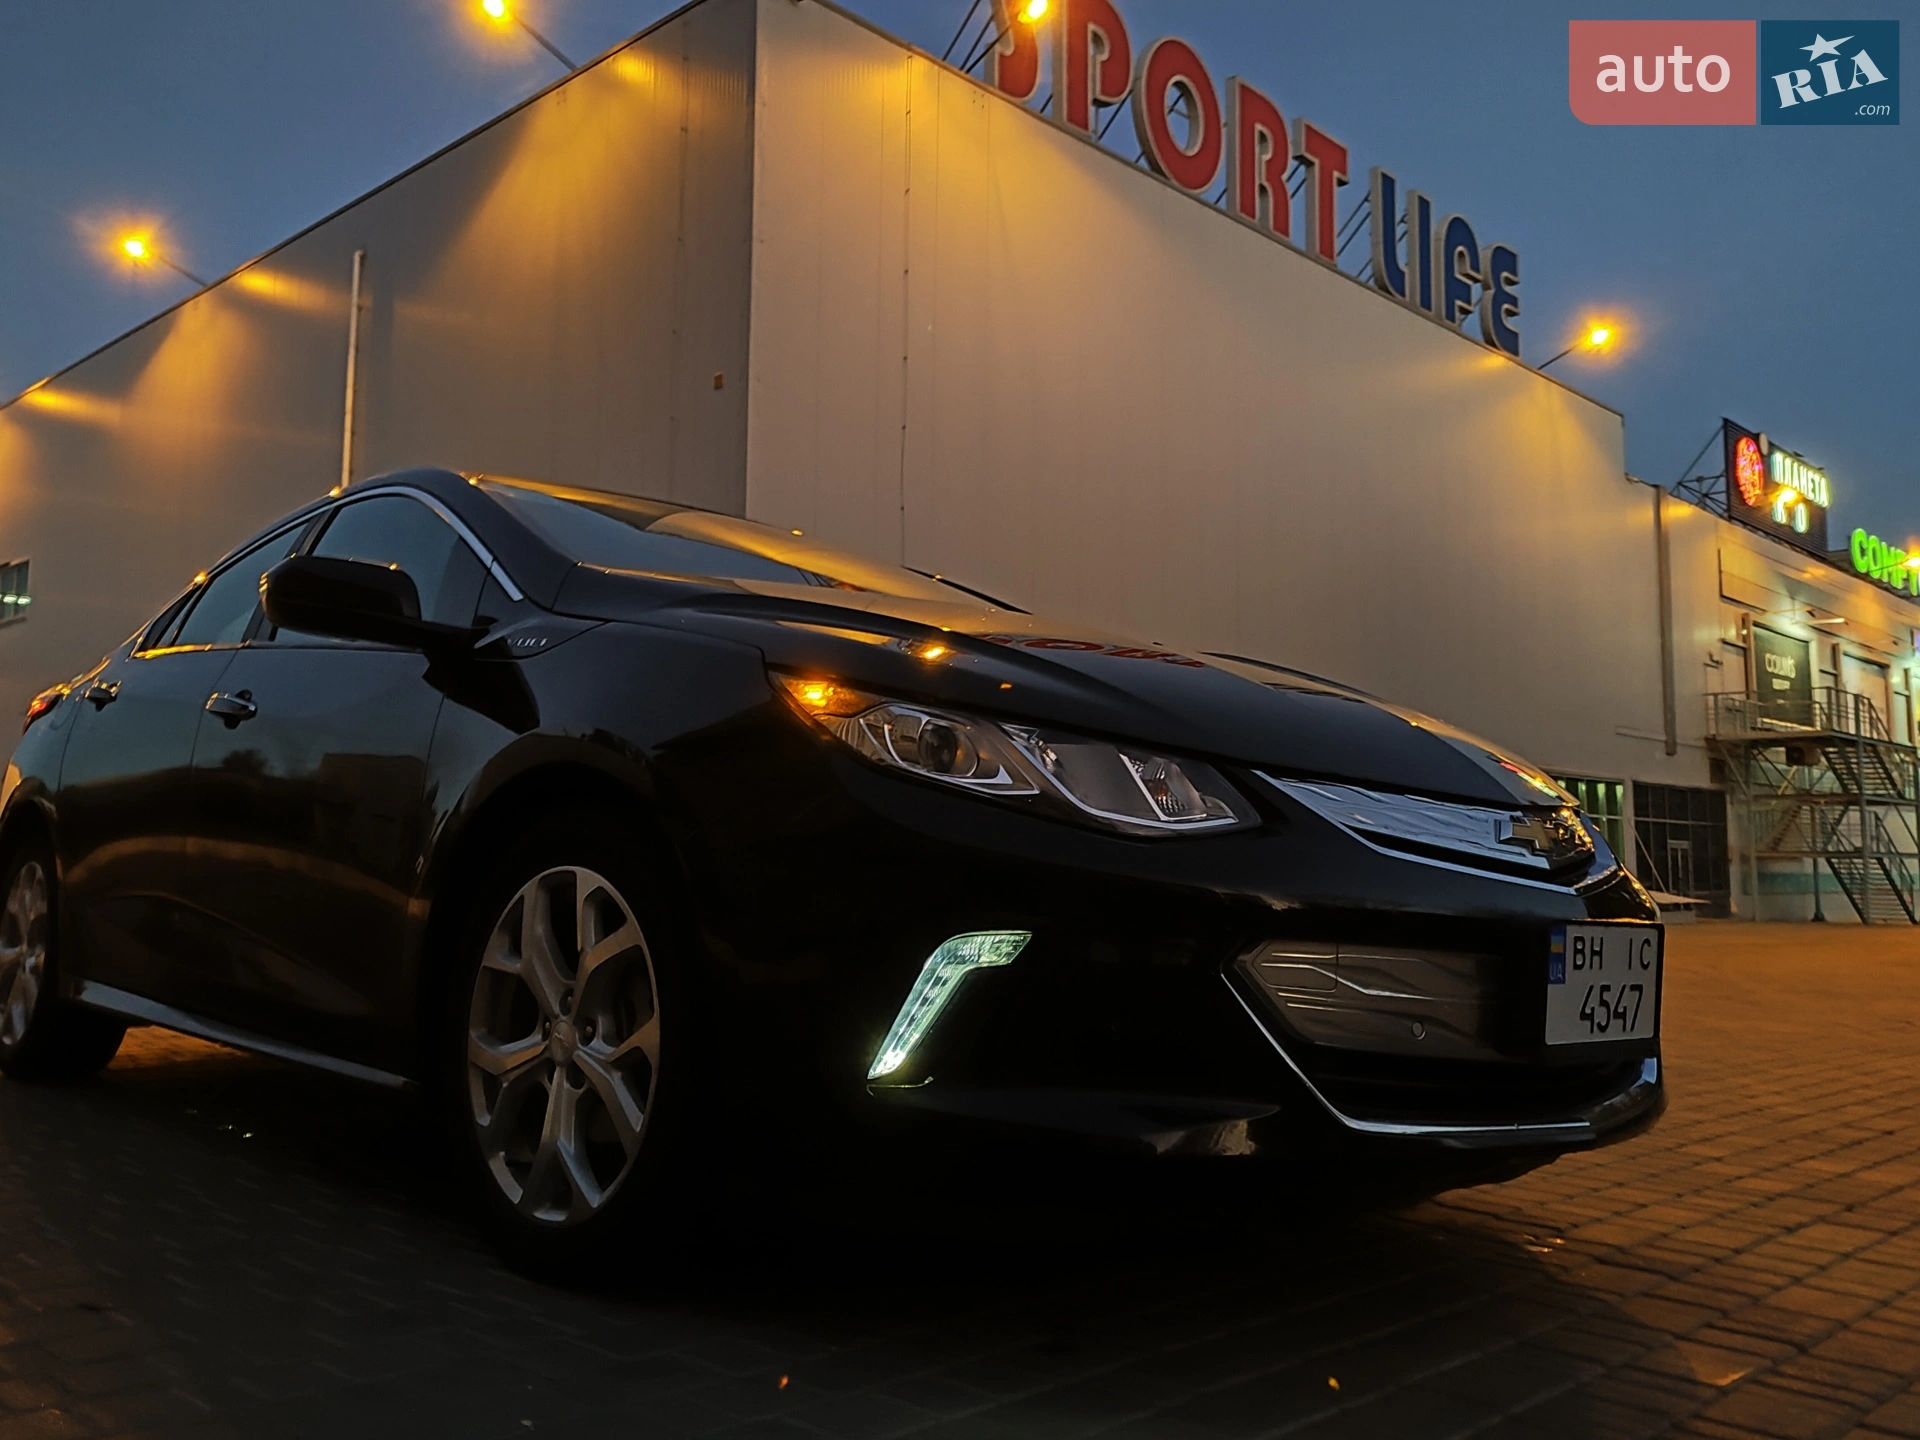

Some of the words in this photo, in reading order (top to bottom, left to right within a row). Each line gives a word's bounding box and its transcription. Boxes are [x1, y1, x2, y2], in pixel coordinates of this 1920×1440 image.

[985, 0, 1349, 267] SPORT
[1371, 166, 1520, 358] LIFE
[1770, 451, 1829, 508] ПЛАНЕТА
[1550, 963, 1564, 981] UA
[1573, 936, 1604, 971] BH
[1628, 938, 1652, 971] IC
[1579, 984, 1644, 1034] 4547
